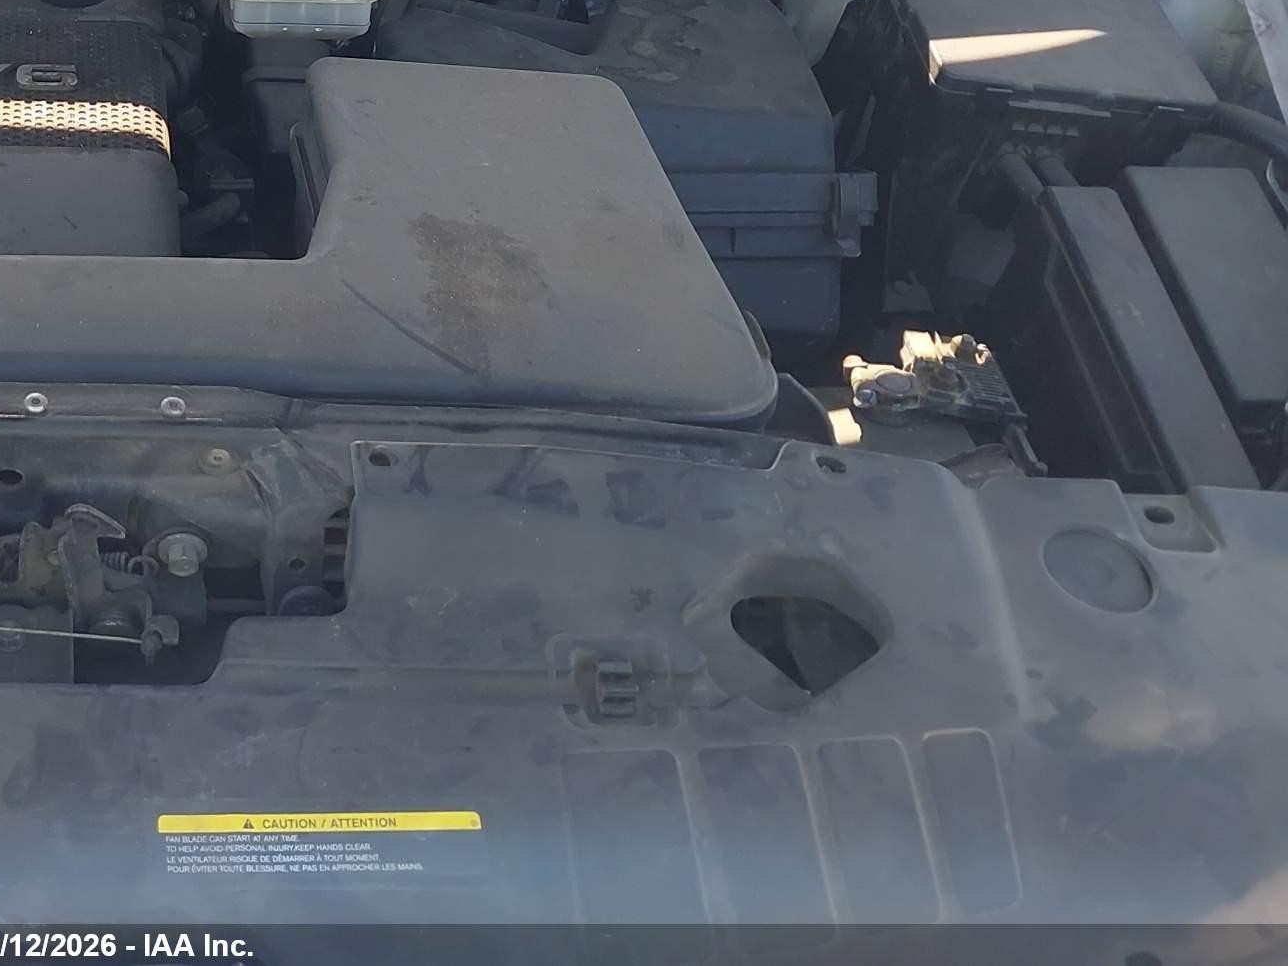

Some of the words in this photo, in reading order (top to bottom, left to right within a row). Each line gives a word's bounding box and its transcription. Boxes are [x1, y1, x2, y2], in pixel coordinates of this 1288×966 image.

[262, 819, 317, 829] CAUTION
[321, 819, 326, 829] /
[330, 818, 397, 828] ATTENTION
[165, 835, 181, 843] FAN
[225, 844, 265, 852] PERSONAL
[178, 855, 228, 863] VENTILATEUR
[229, 855, 258, 863] RISQUE
[272, 853, 314, 862] DÉMARRER
[316, 853, 323, 862] À
[324, 854, 344, 862] TOUT
[192, 864, 218, 873] ÉVITER
[220, 865, 243, 873] TOUTE
[332, 864, 380, 872] APPROCHER
